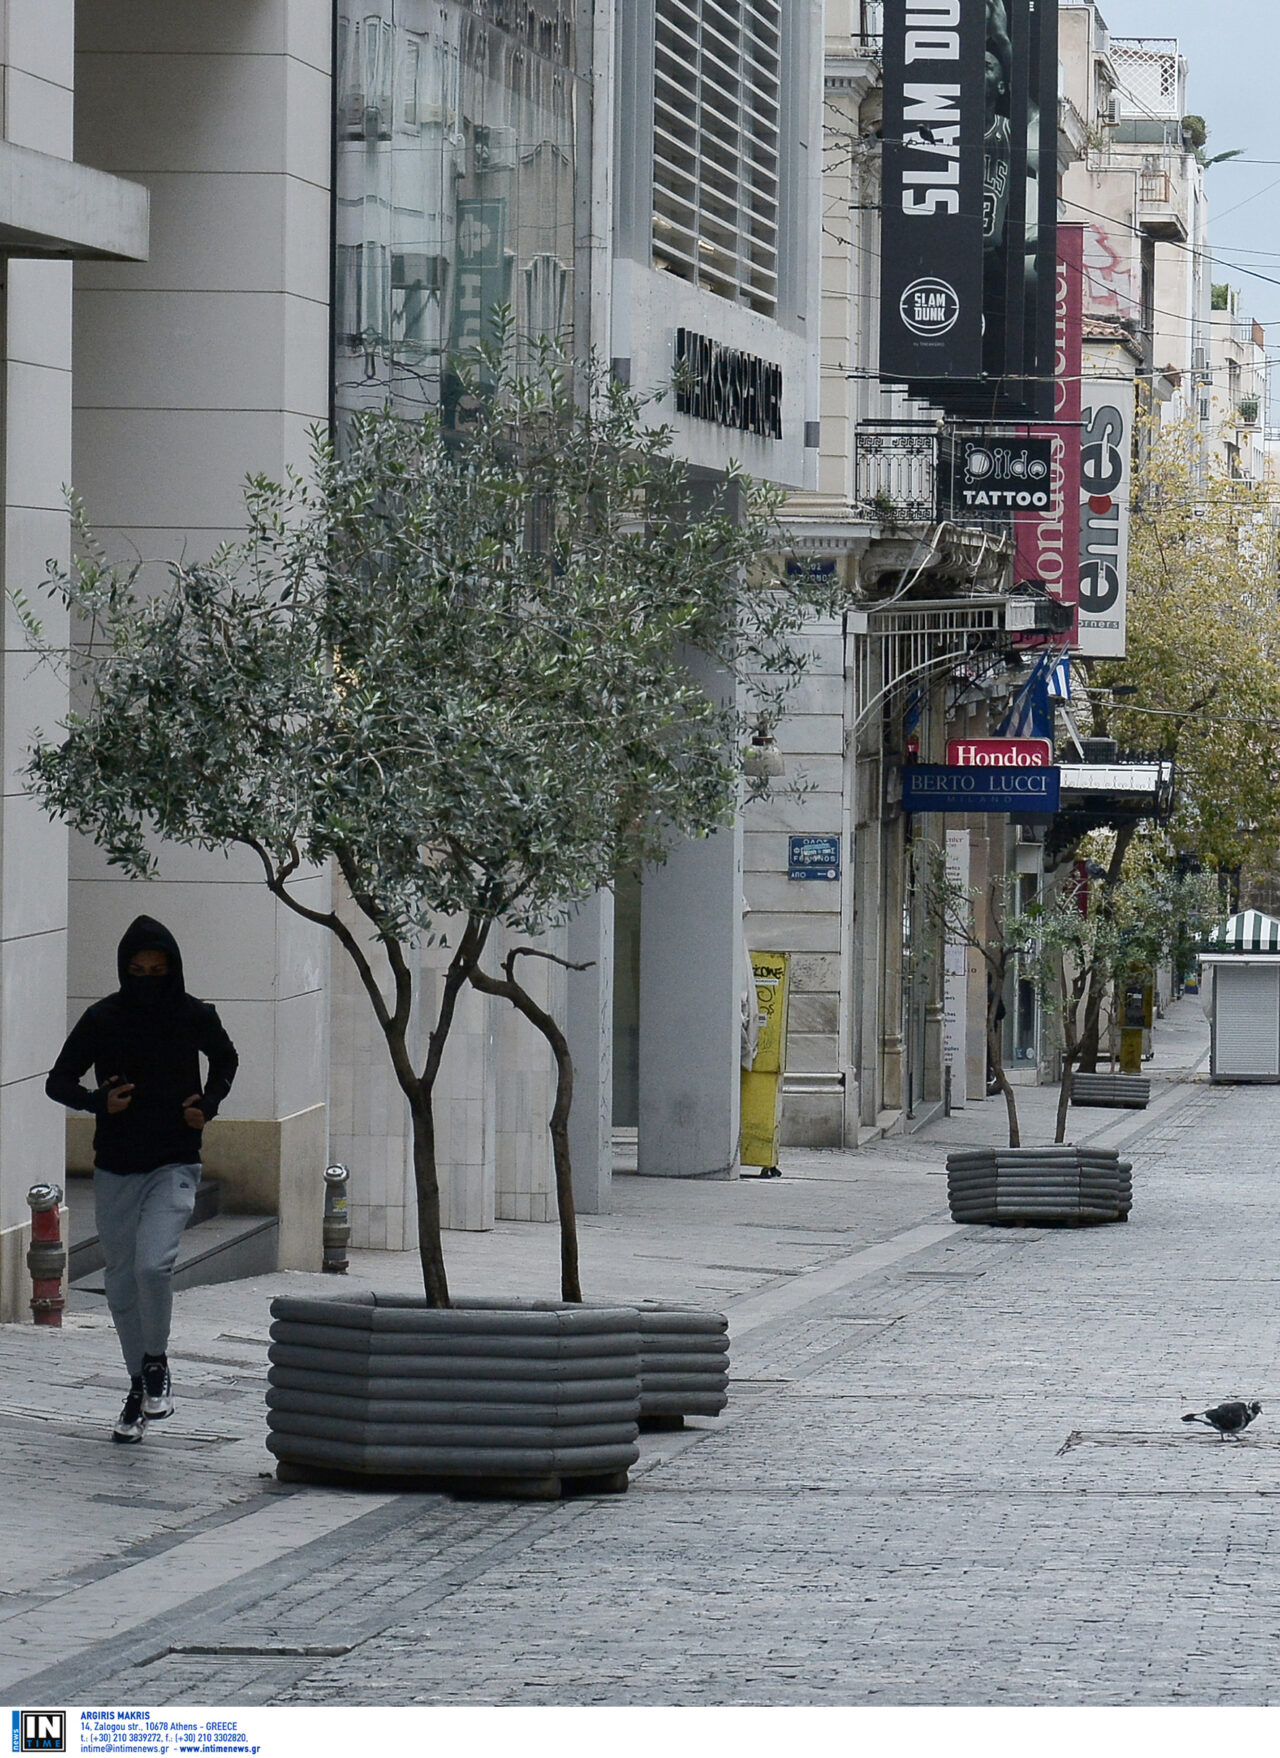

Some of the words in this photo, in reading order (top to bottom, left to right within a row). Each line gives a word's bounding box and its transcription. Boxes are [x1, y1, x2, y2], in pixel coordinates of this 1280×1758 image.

[901, 83, 961, 216] SLAM
[914, 292, 946, 307] SLAM
[914, 307, 946, 321] DUNK
[963, 490, 1048, 506] TATTOO
[956, 745, 1042, 766] Hondos
[911, 774, 975, 791] BERTO
[989, 775, 1047, 791] LUCCI
